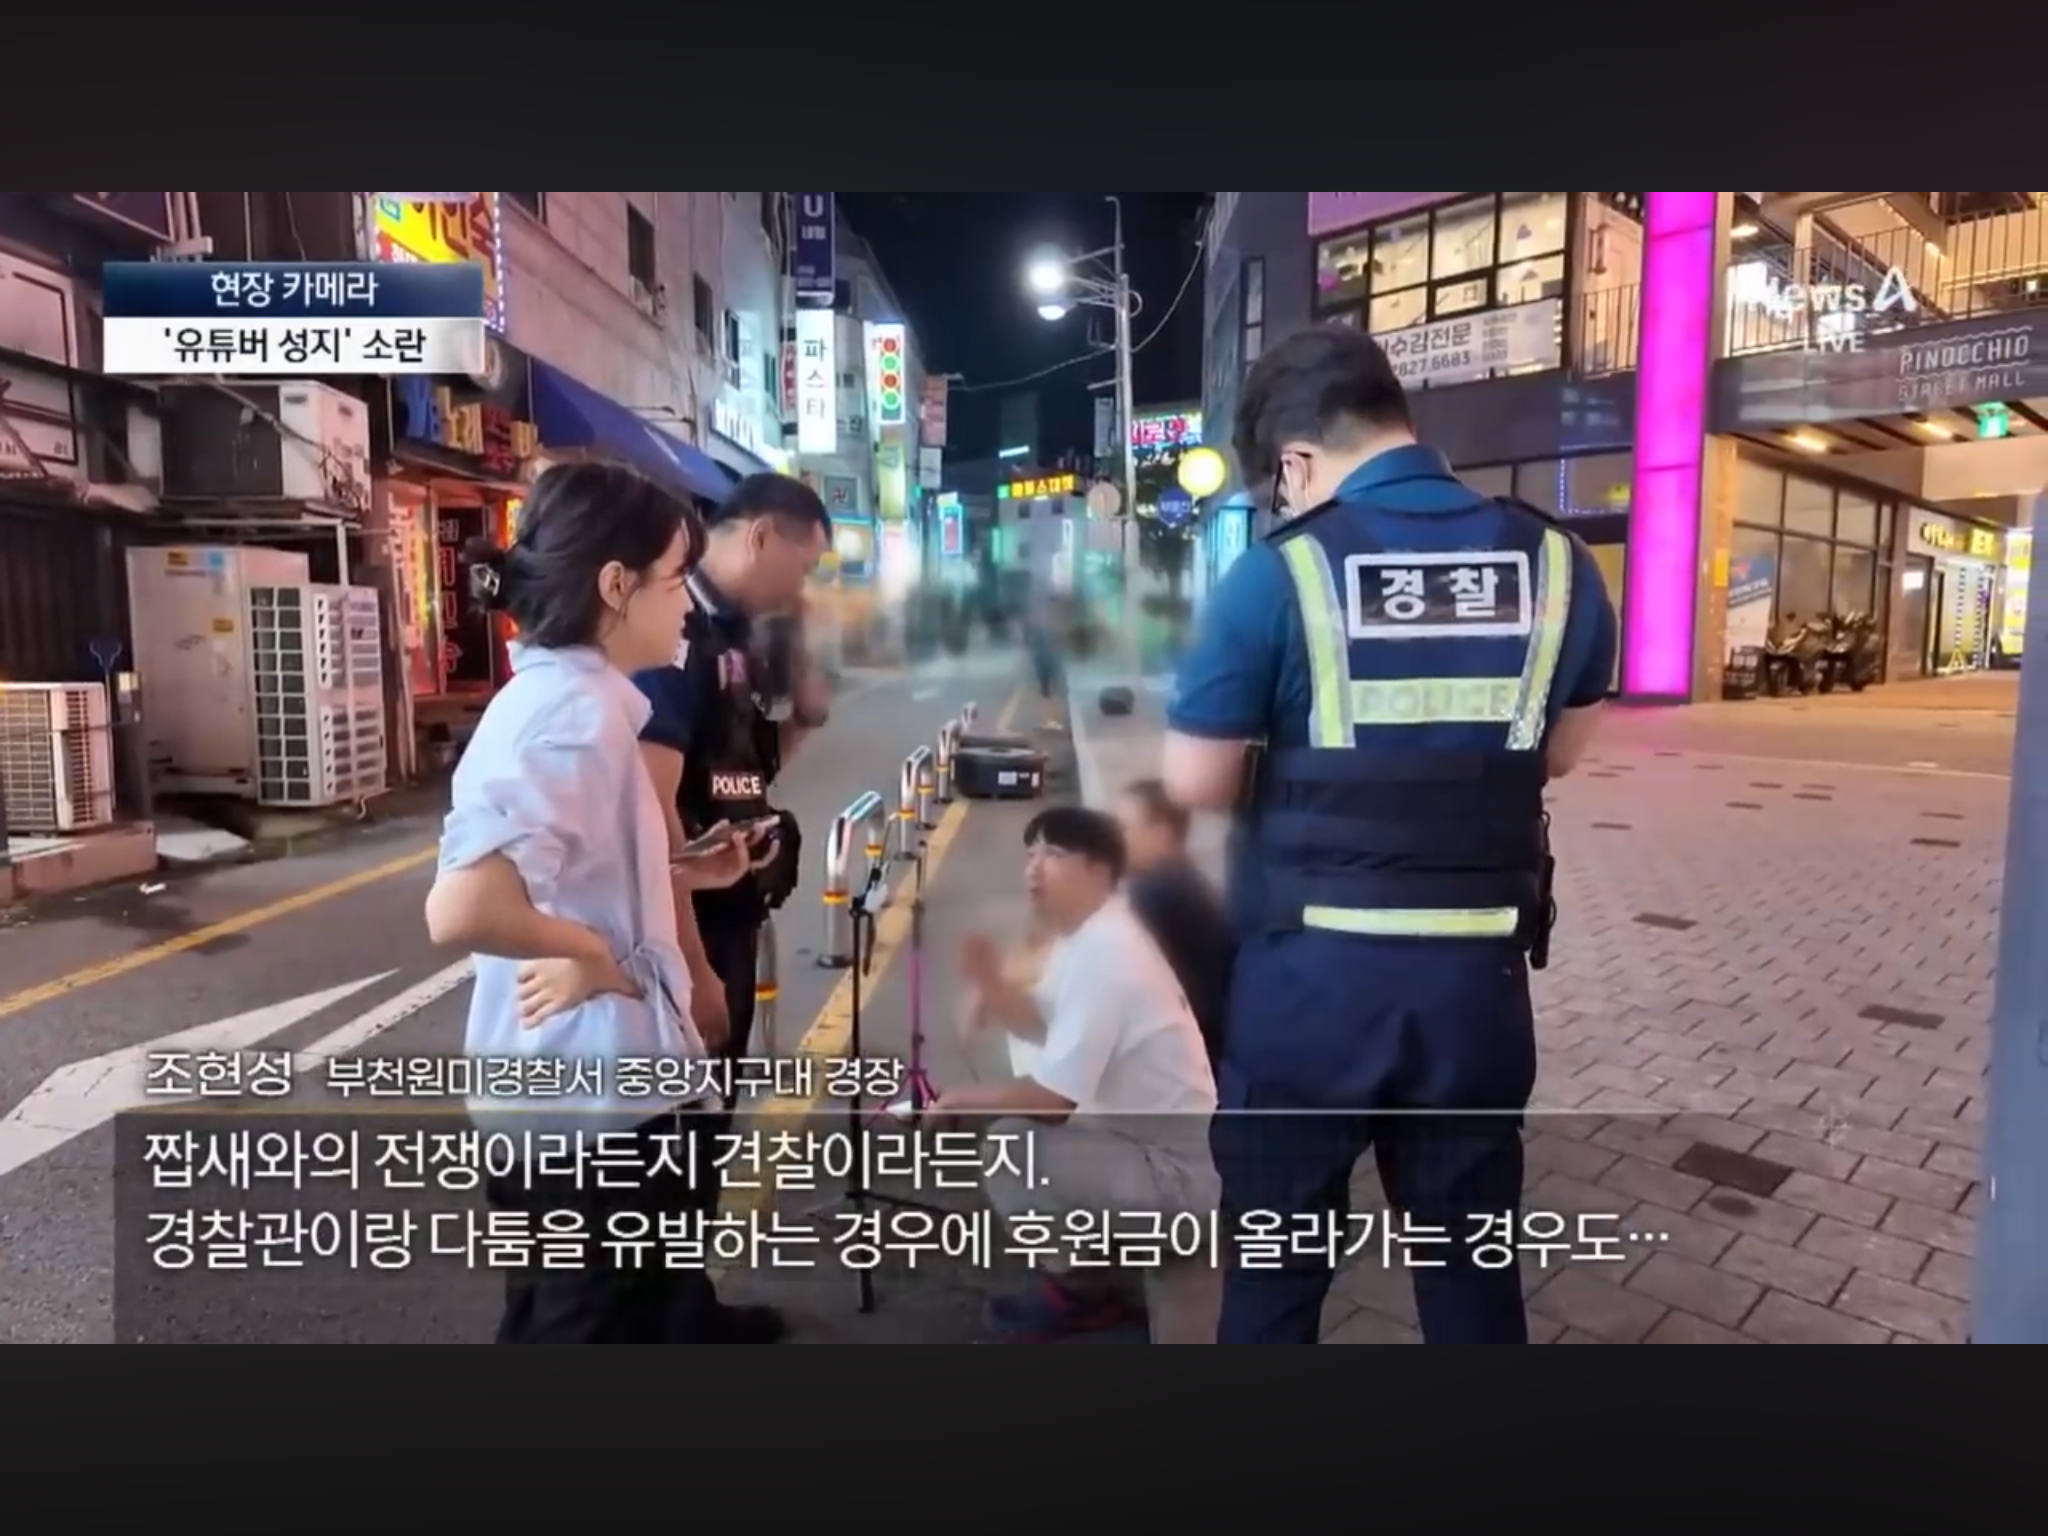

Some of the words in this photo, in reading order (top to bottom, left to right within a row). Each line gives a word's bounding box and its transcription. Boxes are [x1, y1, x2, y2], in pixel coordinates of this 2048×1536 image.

[1899, 335, 2030, 375] PINOCCHIO
[1897, 374, 1967, 402] STREET
[1975, 371, 2026, 391] MALL
[1358, 683, 1511, 719] POLICE
[712, 775, 762, 796] POLICE
